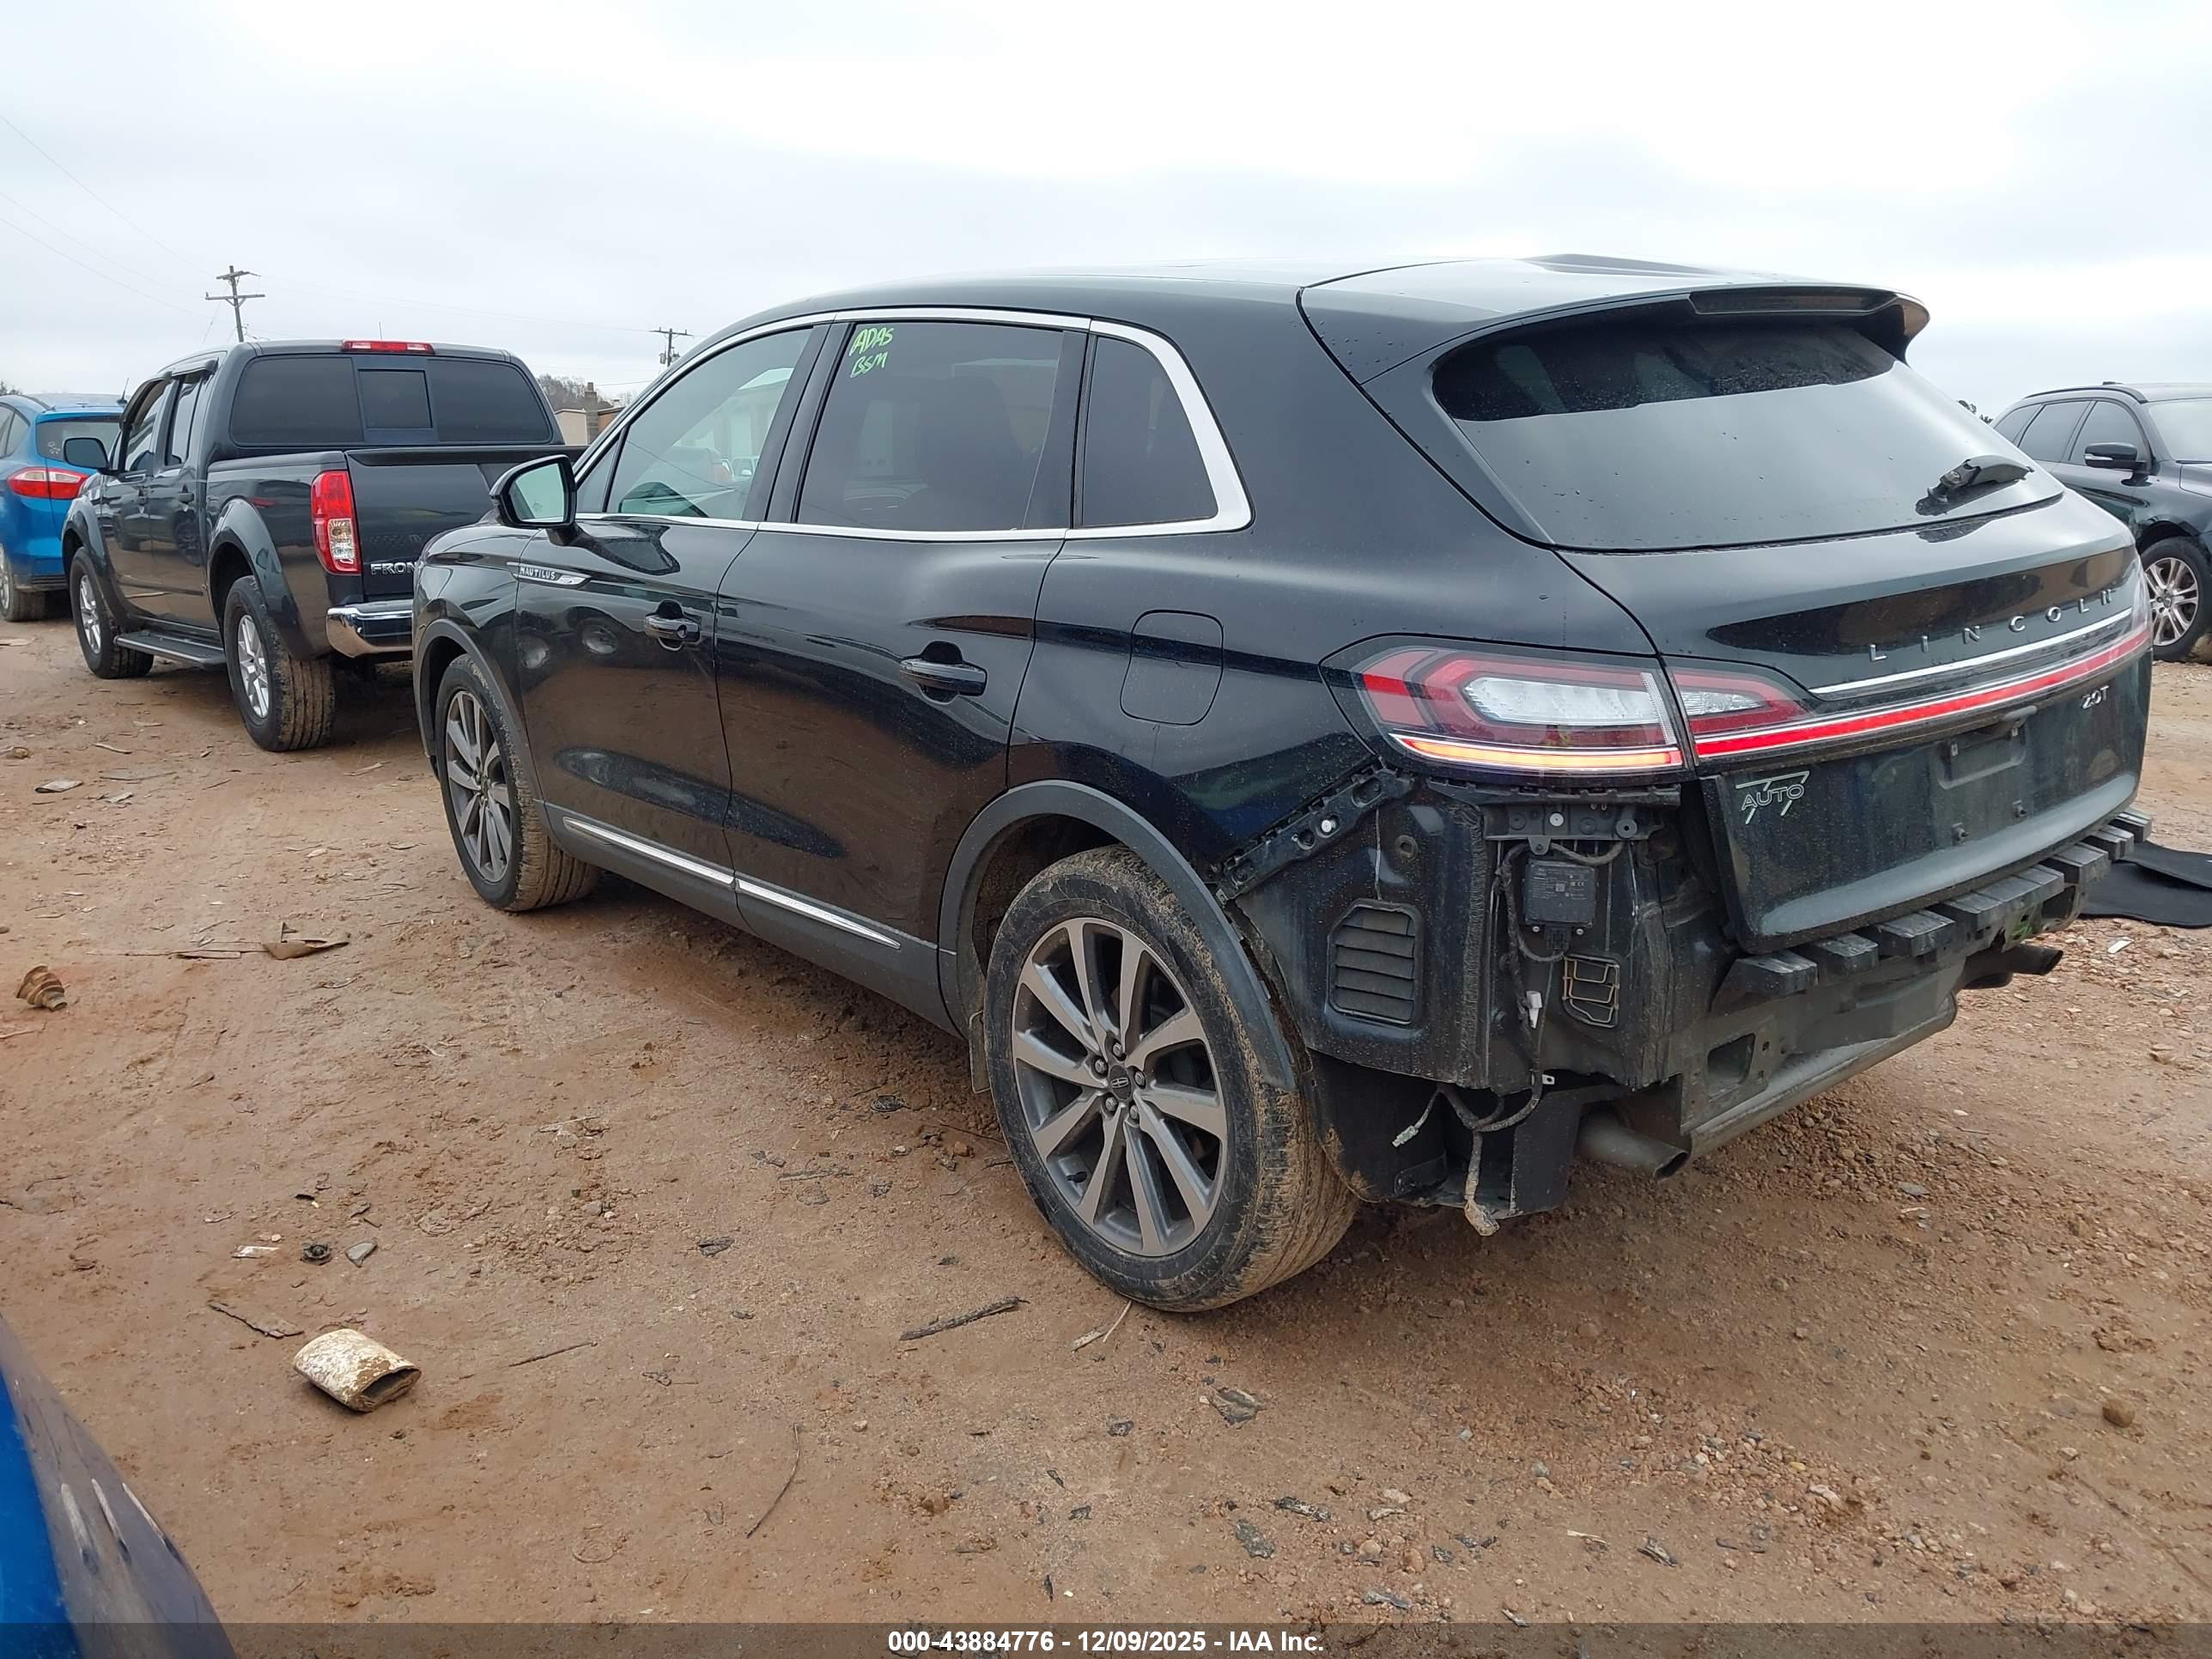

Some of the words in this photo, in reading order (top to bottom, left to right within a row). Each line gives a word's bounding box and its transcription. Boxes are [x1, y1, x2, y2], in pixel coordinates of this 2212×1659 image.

[850, 327, 895, 355] ADAS
[850, 352, 888, 378] BSM
[520, 566, 556, 580] NAUTILUS
[1869, 589, 2117, 662] LINCOLN
[1741, 784, 1805, 811] AUTO
